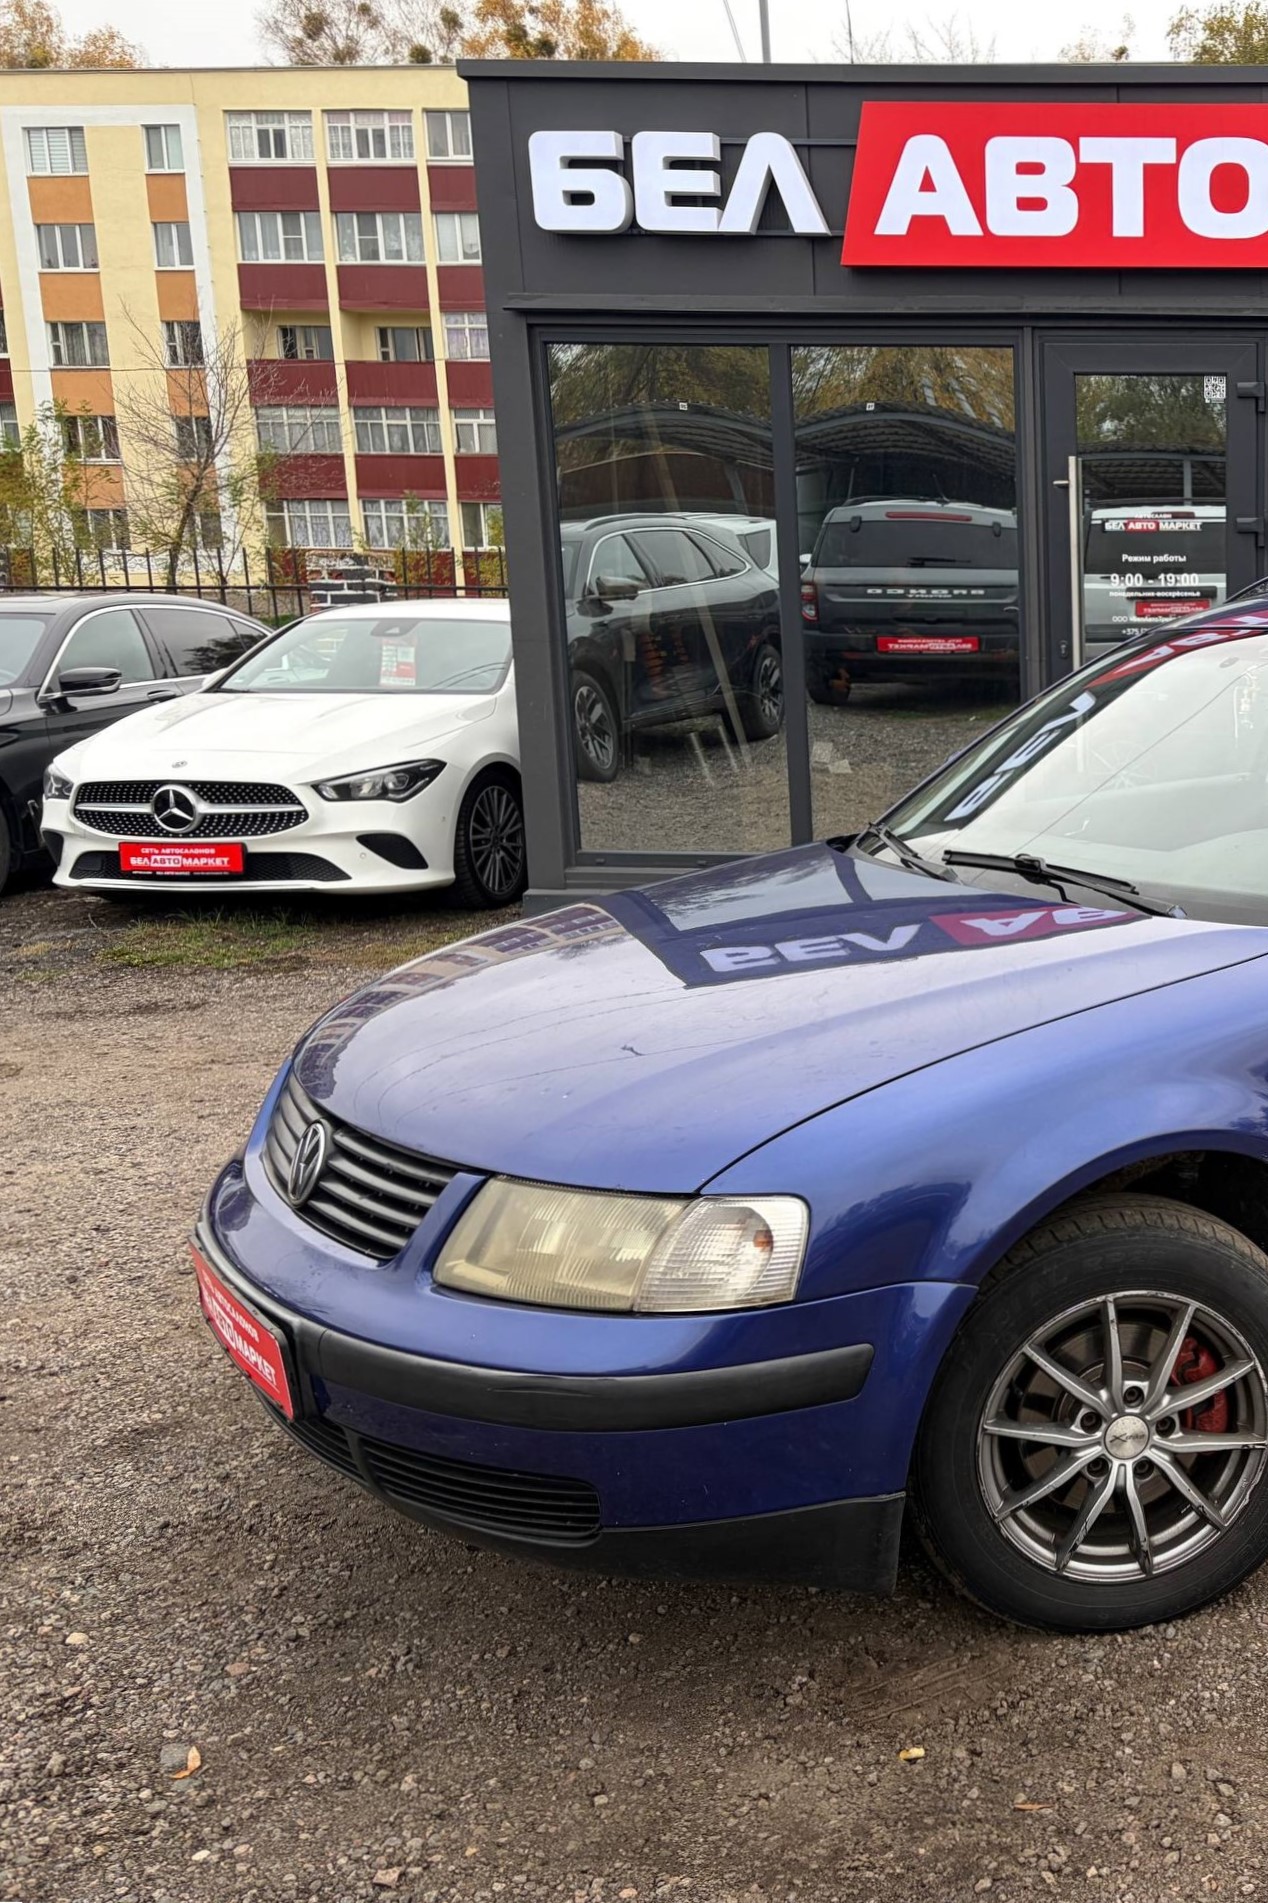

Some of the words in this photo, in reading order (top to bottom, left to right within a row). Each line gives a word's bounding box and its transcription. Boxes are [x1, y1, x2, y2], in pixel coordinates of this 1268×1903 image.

[527, 130, 831, 236] БЕЛ
[1105, 522, 1125, 530] БЕЛ
[1128, 521, 1156, 530] АВТО
[1159, 522, 1203, 531] МАРКЕТ
[1121, 553, 1151, 562] Режим
[1152, 553, 1187, 564] работы
[1110, 573, 1143, 586] 9:00
[1158, 573, 1199, 587] 19:00
[152, 857, 181, 866] АВТО
[183, 857, 230, 866] МАРКЕТ
